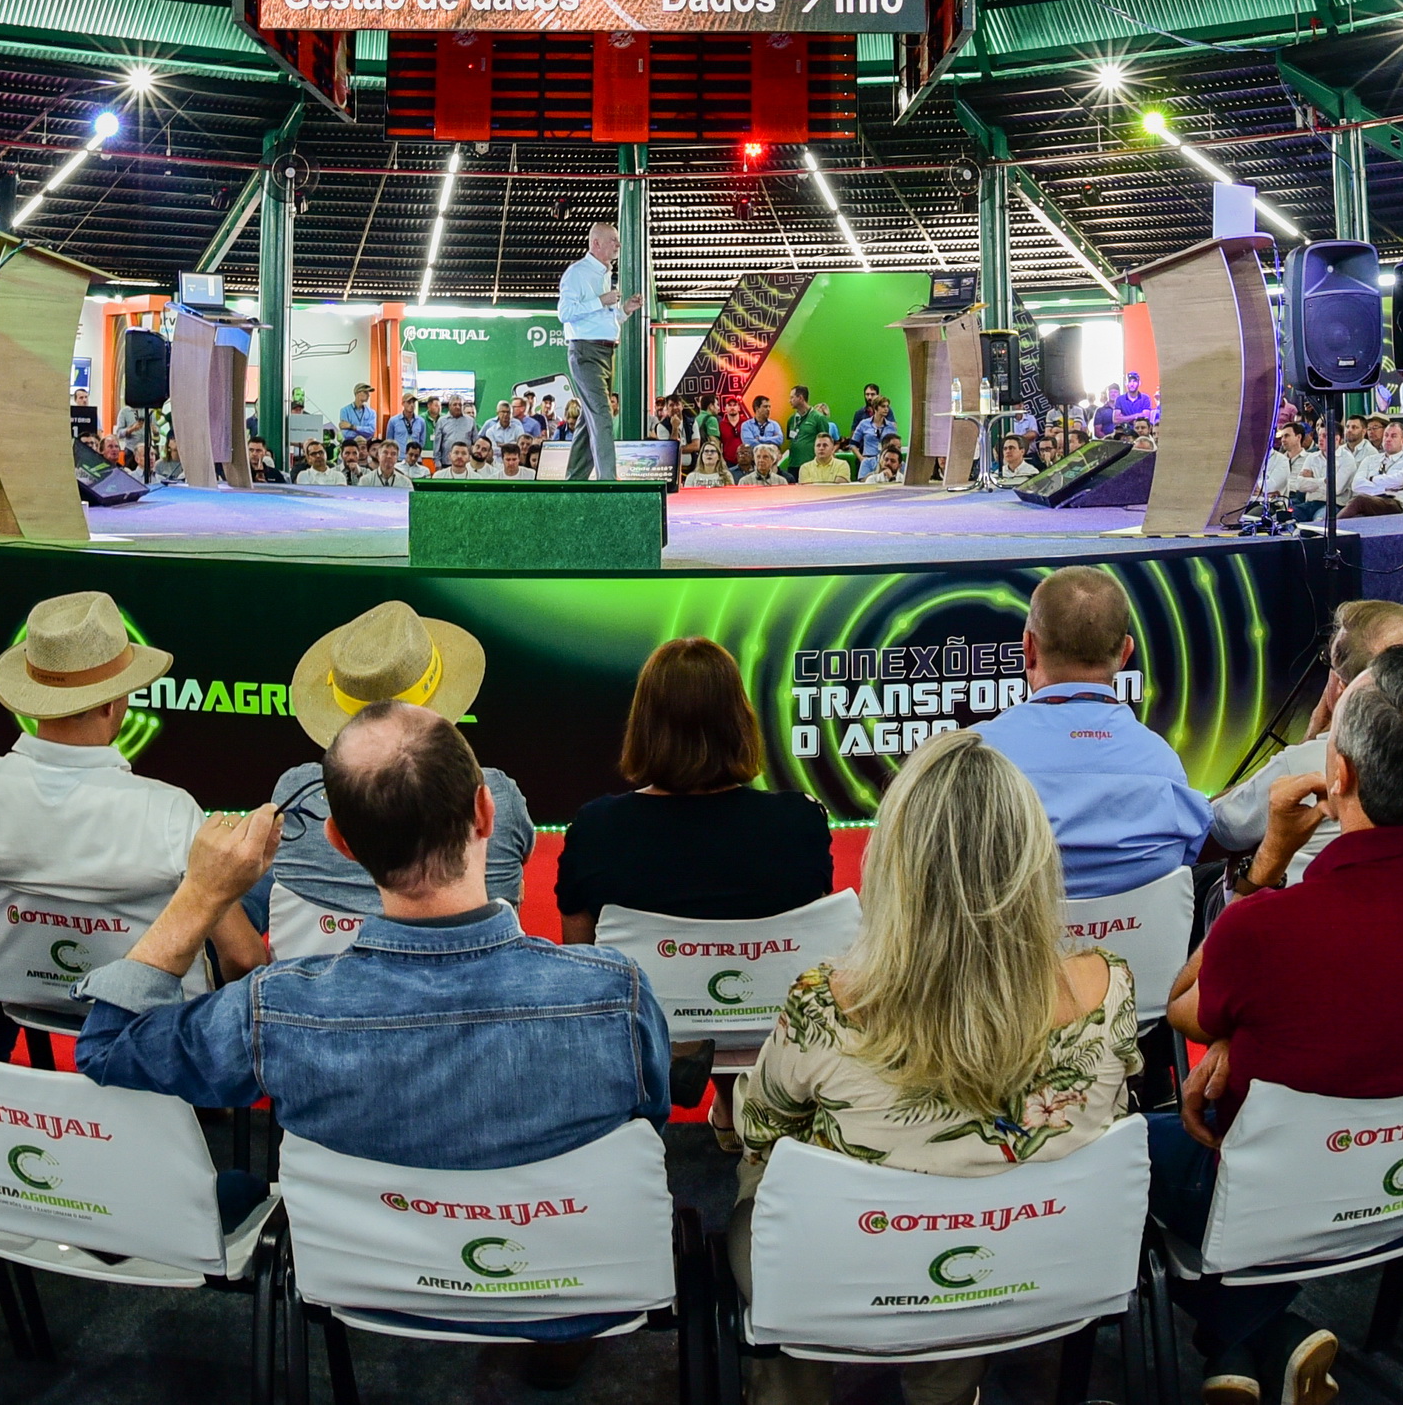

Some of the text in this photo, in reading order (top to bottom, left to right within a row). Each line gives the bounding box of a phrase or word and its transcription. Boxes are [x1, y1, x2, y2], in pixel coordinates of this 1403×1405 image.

[403, 325, 490, 345] COTRIJAL
[793, 636, 1026, 682] CONEXÕES
[791, 670, 1144, 720] TRANSFORM
[791, 719, 959, 758] O AGR
[1069, 730, 1113, 740] COTRIJAL
[6, 904, 131, 935] COTRIJAL
[1064, 915, 1143, 940] RIJAL
[656, 938, 802, 962] COTRIJAL
[380, 1191, 589, 1226] COTRIJAL
[858, 1198, 1067, 1235] COTRIJAL
